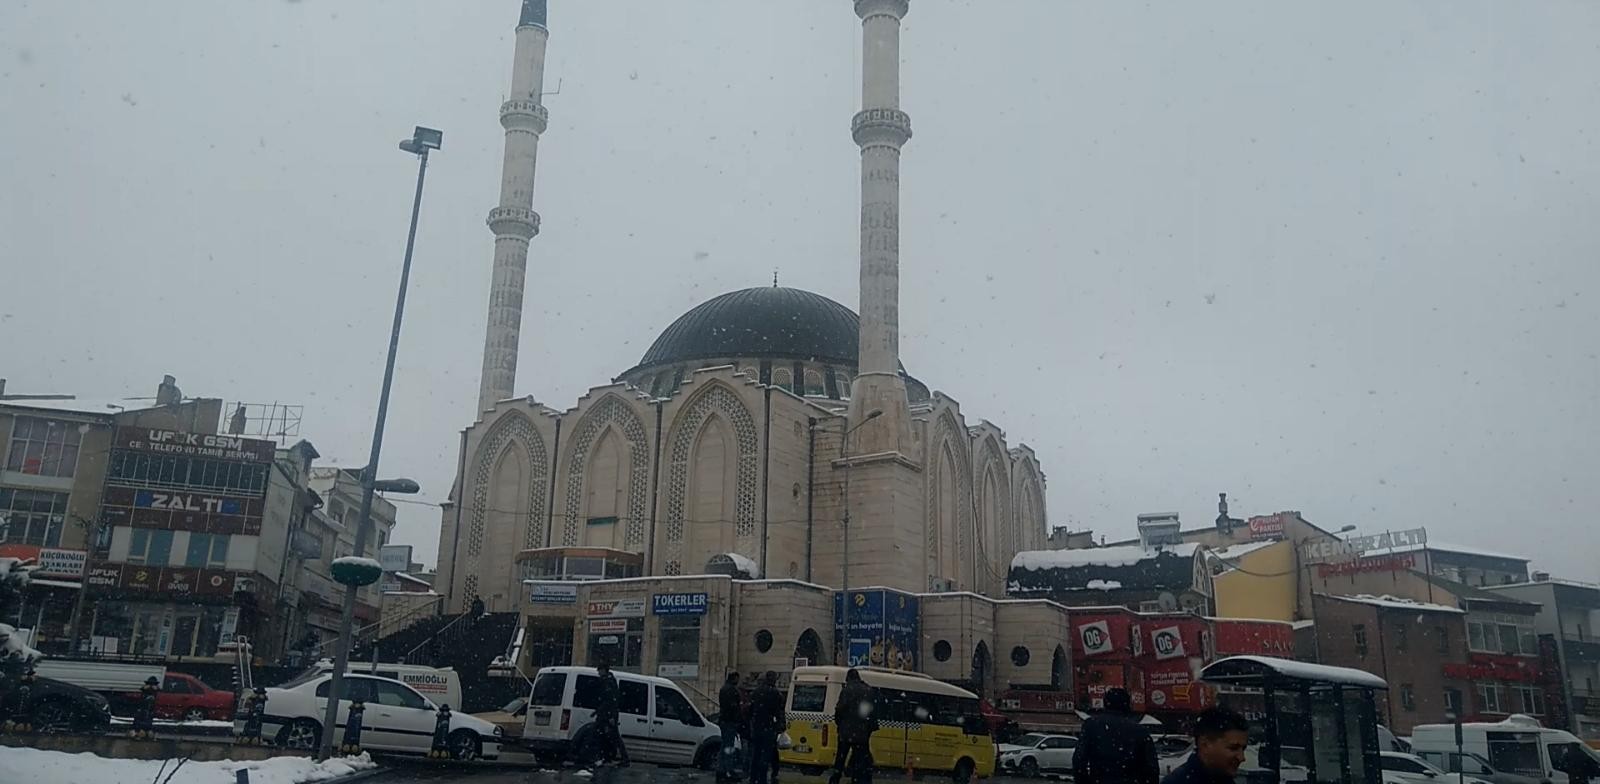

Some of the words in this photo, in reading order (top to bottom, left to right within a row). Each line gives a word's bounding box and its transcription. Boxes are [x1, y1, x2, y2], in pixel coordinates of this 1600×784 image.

[129, 440, 146, 449] CE
[149, 429, 198, 445] UFK
[203, 434, 243, 451] GSM
[88, 577, 115, 587] GSM
[654, 594, 706, 606] TOKERLER
[597, 603, 614, 611] THY
[1085, 629, 1101, 646] DG
[1156, 635, 1173, 651] DG
[403, 674, 448, 684] EMMİOĞLU
